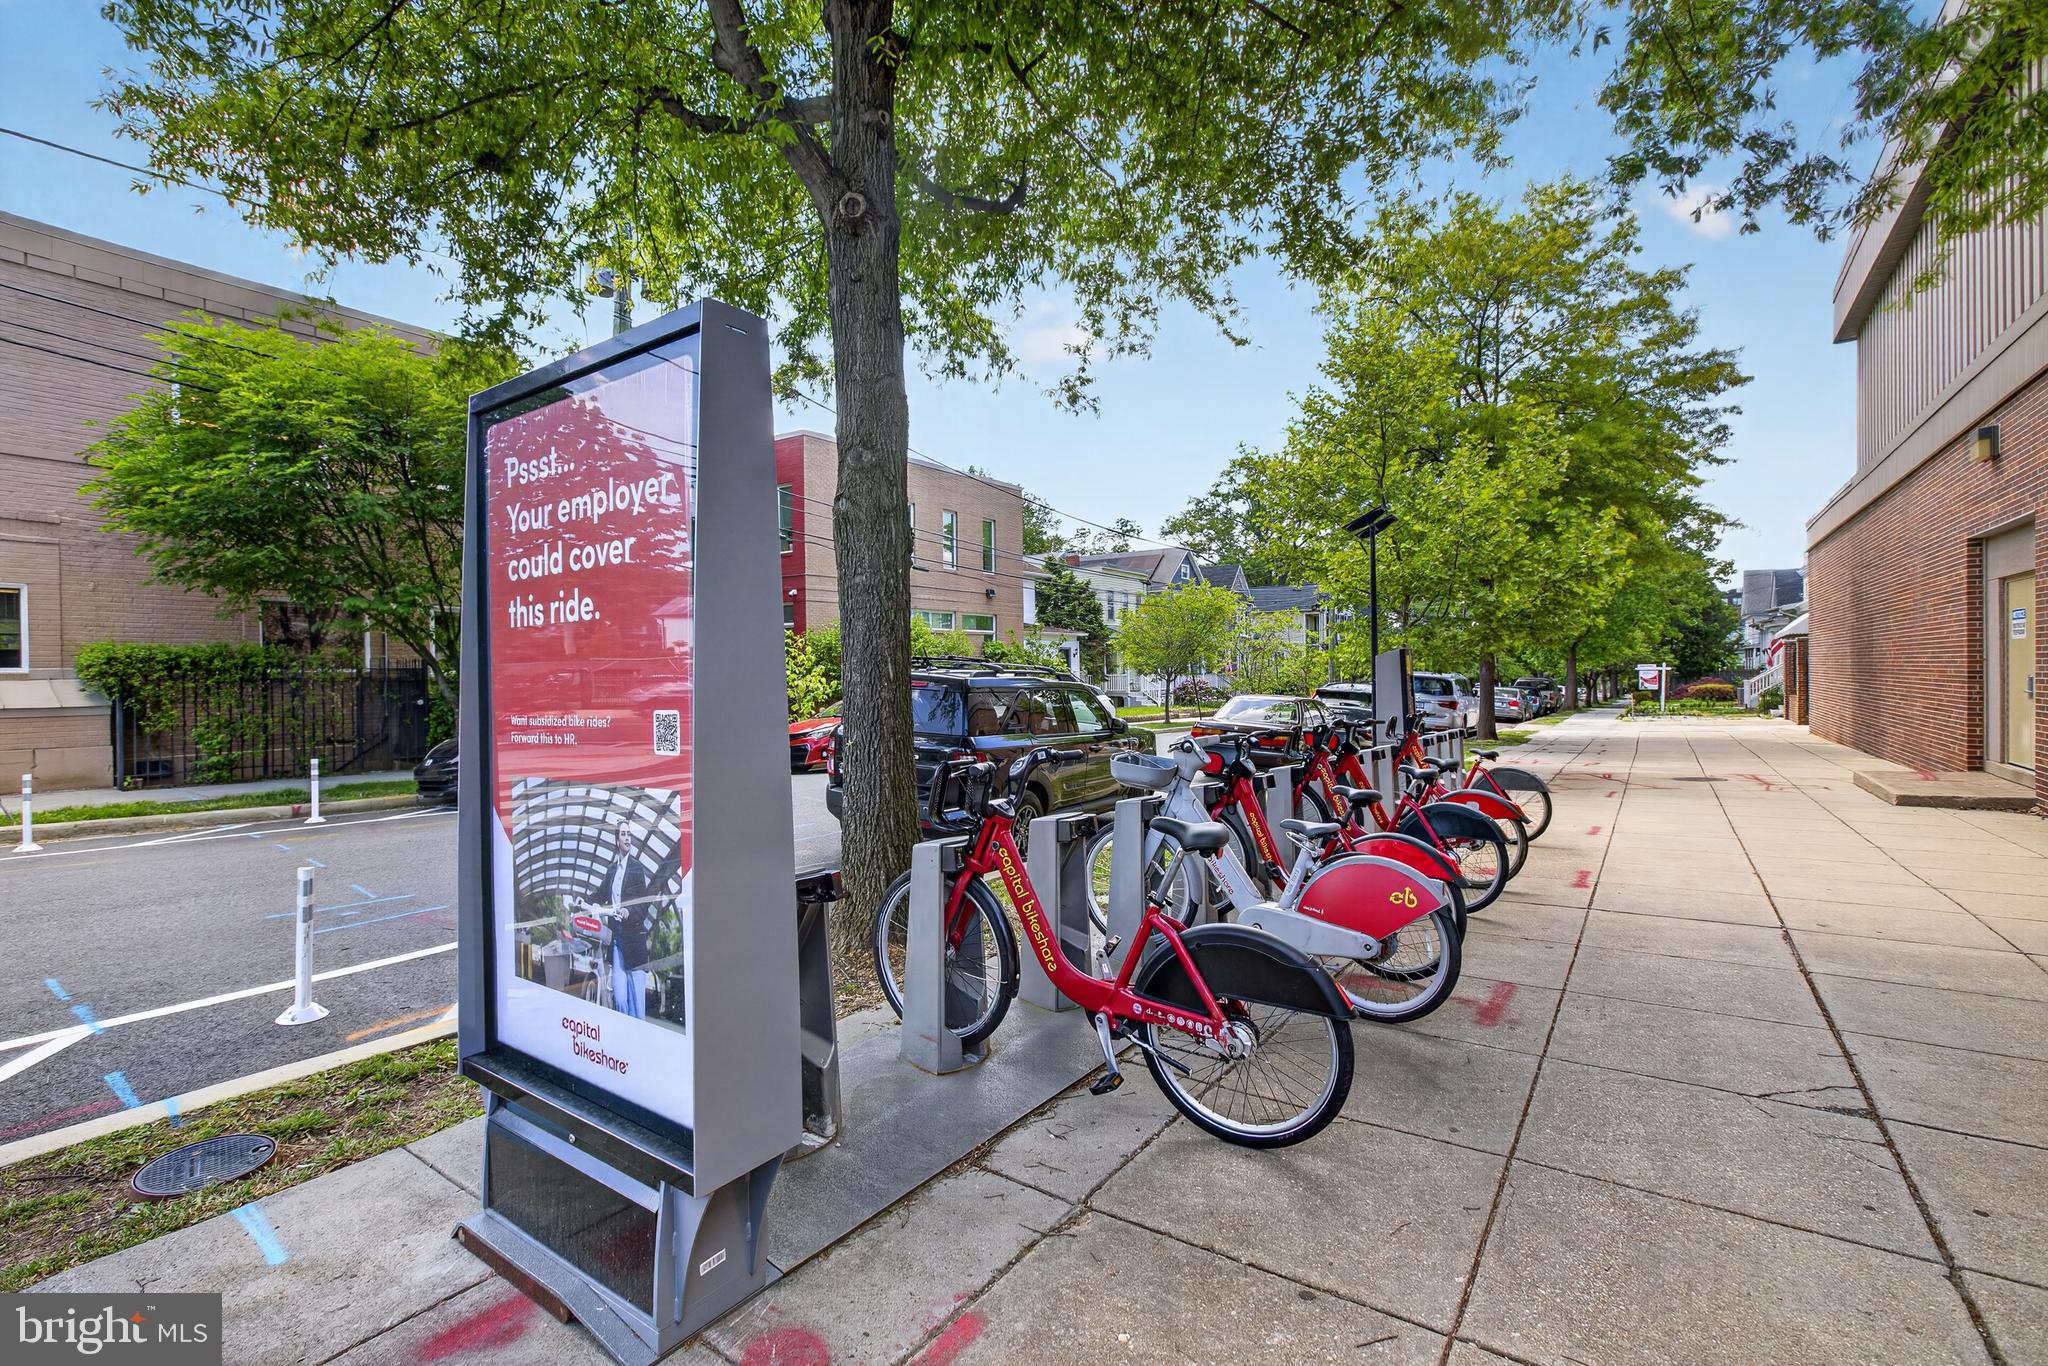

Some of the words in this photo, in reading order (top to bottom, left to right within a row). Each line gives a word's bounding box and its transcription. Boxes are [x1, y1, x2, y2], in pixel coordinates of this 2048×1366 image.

[504, 446, 575, 488] Pssst...
[506, 501, 553, 534] Your
[557, 471, 676, 524] employer
[508, 540, 562, 581] could
[569, 537, 636, 571] cover
[508, 594, 544, 628] this
[550, 587, 600, 624] ride.
[510, 715, 528, 726] Want
[528, 714, 567, 727] subsidized
[568, 715, 585, 727] bike
[586, 715, 611, 728] rides?
[510, 732, 539, 744] Forward
[540, 732, 553, 744] this
[554, 734, 563, 745] to
[564, 733, 578, 746] HR.
[998, 846, 1030, 899] capital
[1021, 899, 1058, 972] bikeshare
[561, 1016, 601, 1042] capital
